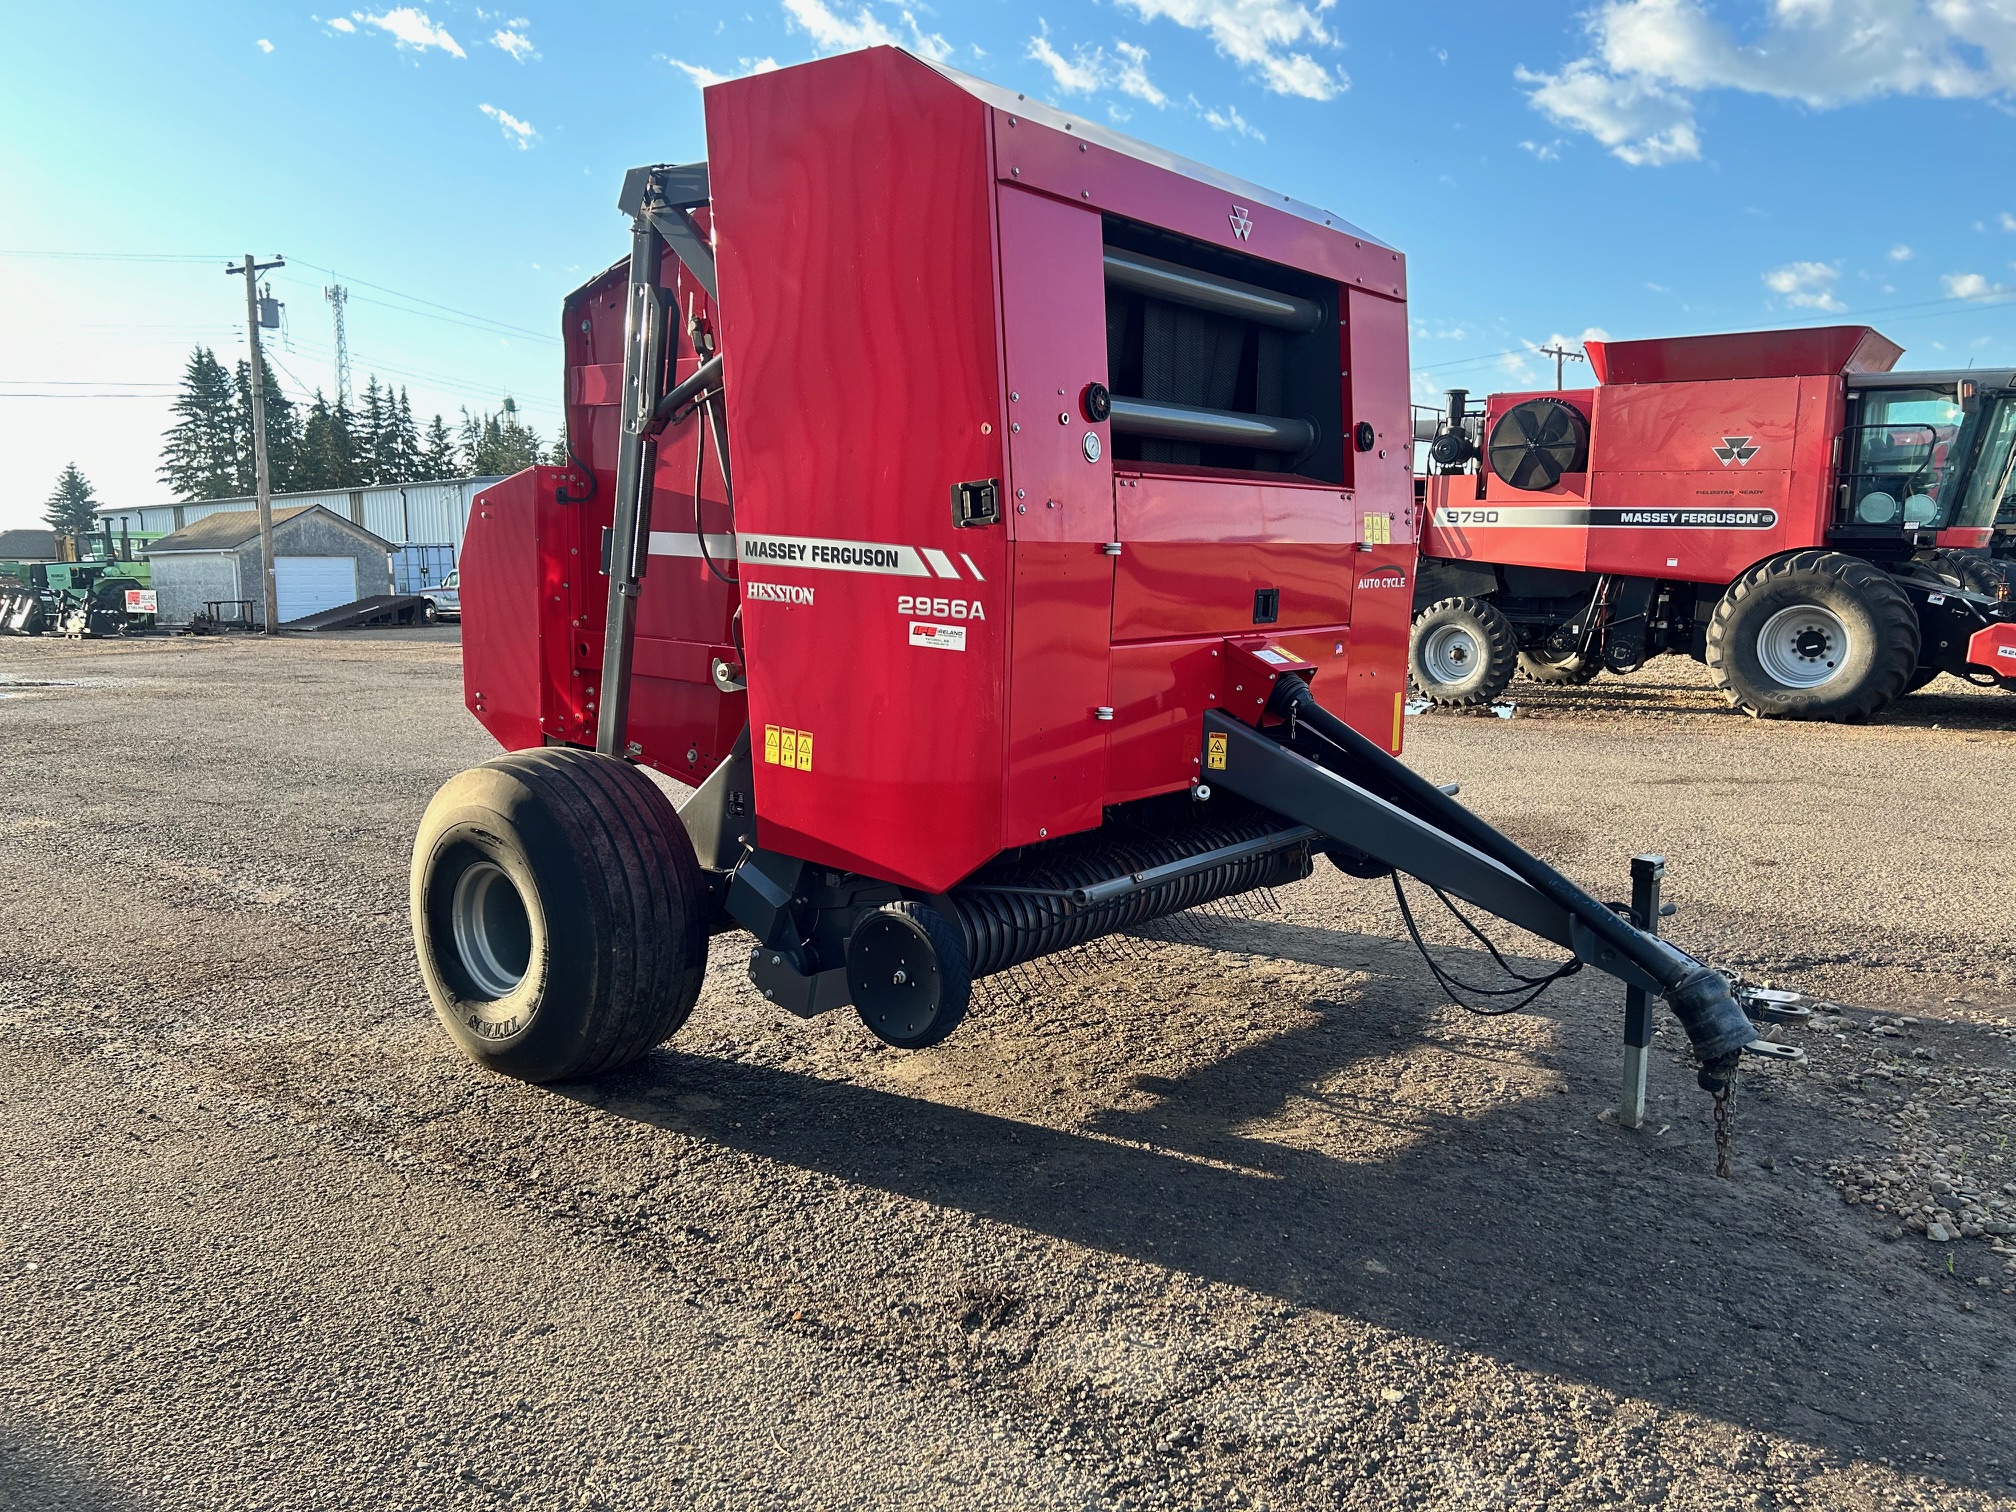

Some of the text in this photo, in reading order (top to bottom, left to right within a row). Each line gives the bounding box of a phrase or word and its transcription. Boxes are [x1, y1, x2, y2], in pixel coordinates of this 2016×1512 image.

[1446, 511, 1499, 523] 9790
[1620, 512, 1678, 523] MASSEY
[1681, 513, 1758, 524] FERGUSON
[745, 540, 899, 568] MASSEY FERGUSON
[746, 582, 815, 605] HESSTON
[1358, 577, 1406, 589] AUTO CYCLE
[897, 595, 986, 621] 2956A
[466, 1013, 521, 1039] TITAN
